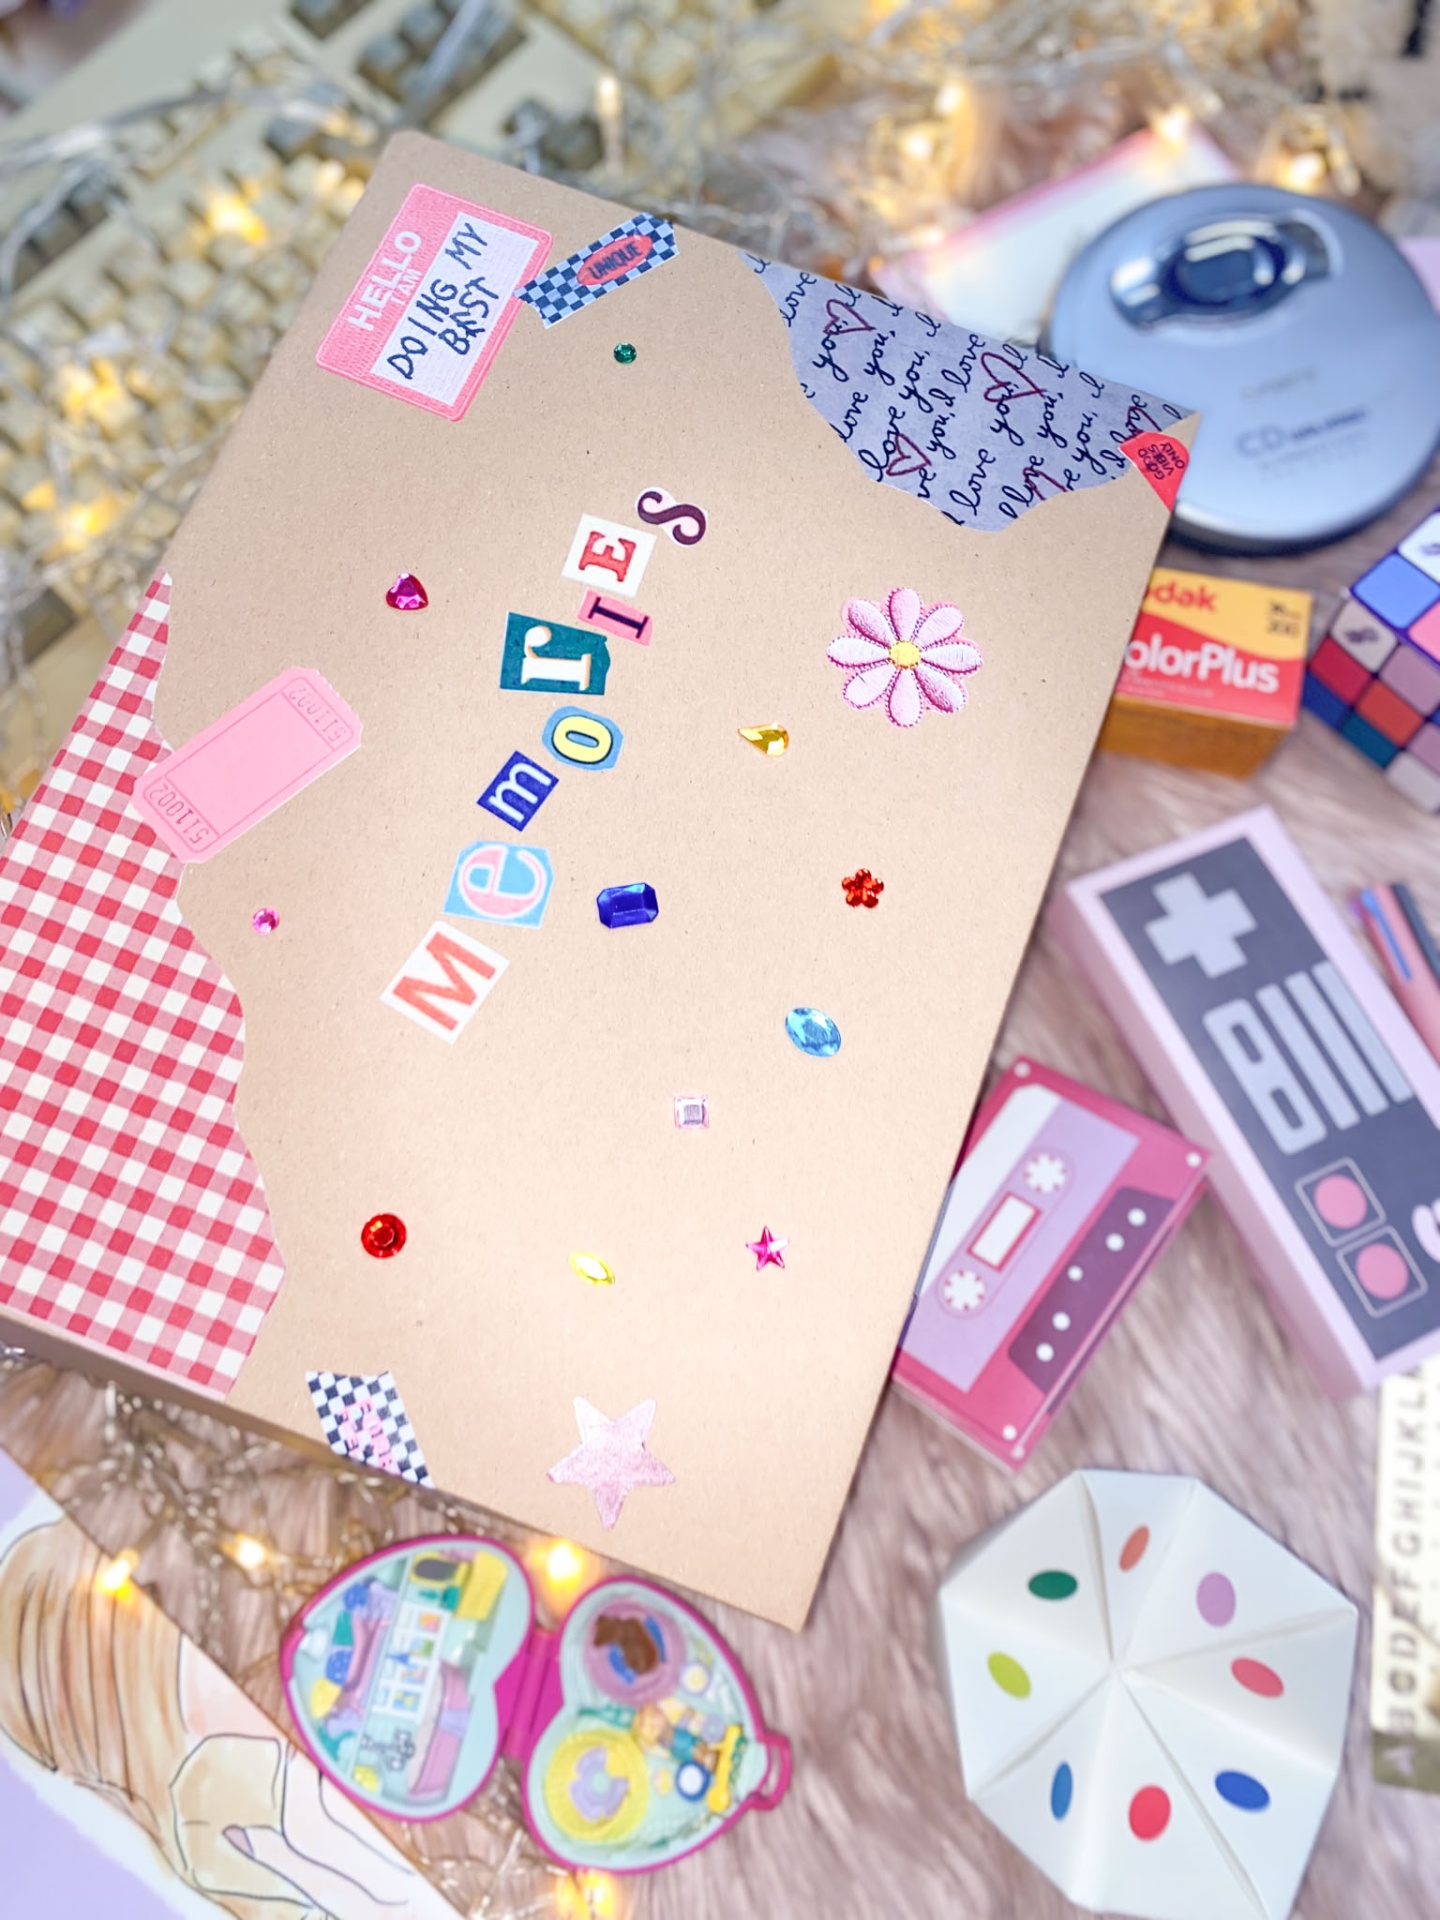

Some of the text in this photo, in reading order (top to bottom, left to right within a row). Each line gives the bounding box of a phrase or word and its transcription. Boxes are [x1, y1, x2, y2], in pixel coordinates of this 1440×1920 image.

[348, 230, 421, 331] HELLO
[392, 268, 422, 305] I AM
[587, 240, 642, 279] UNIQUE
[386, 222, 488, 380] DOING MY
[779, 272, 817, 327] love
[941, 334, 986, 393] love
[858, 406, 906, 482] love
[1137, 447, 1165, 481] GOOD
[1150, 443, 1175, 477] VIBES
[1160, 441, 1186, 470] ONLY
[949, 448, 997, 517] love
[1147, 580, 1217, 612] dak
[1123, 632, 1279, 694] olorPlus
[289, 686, 348, 742] 511002
[149, 781, 210, 845] 511002
